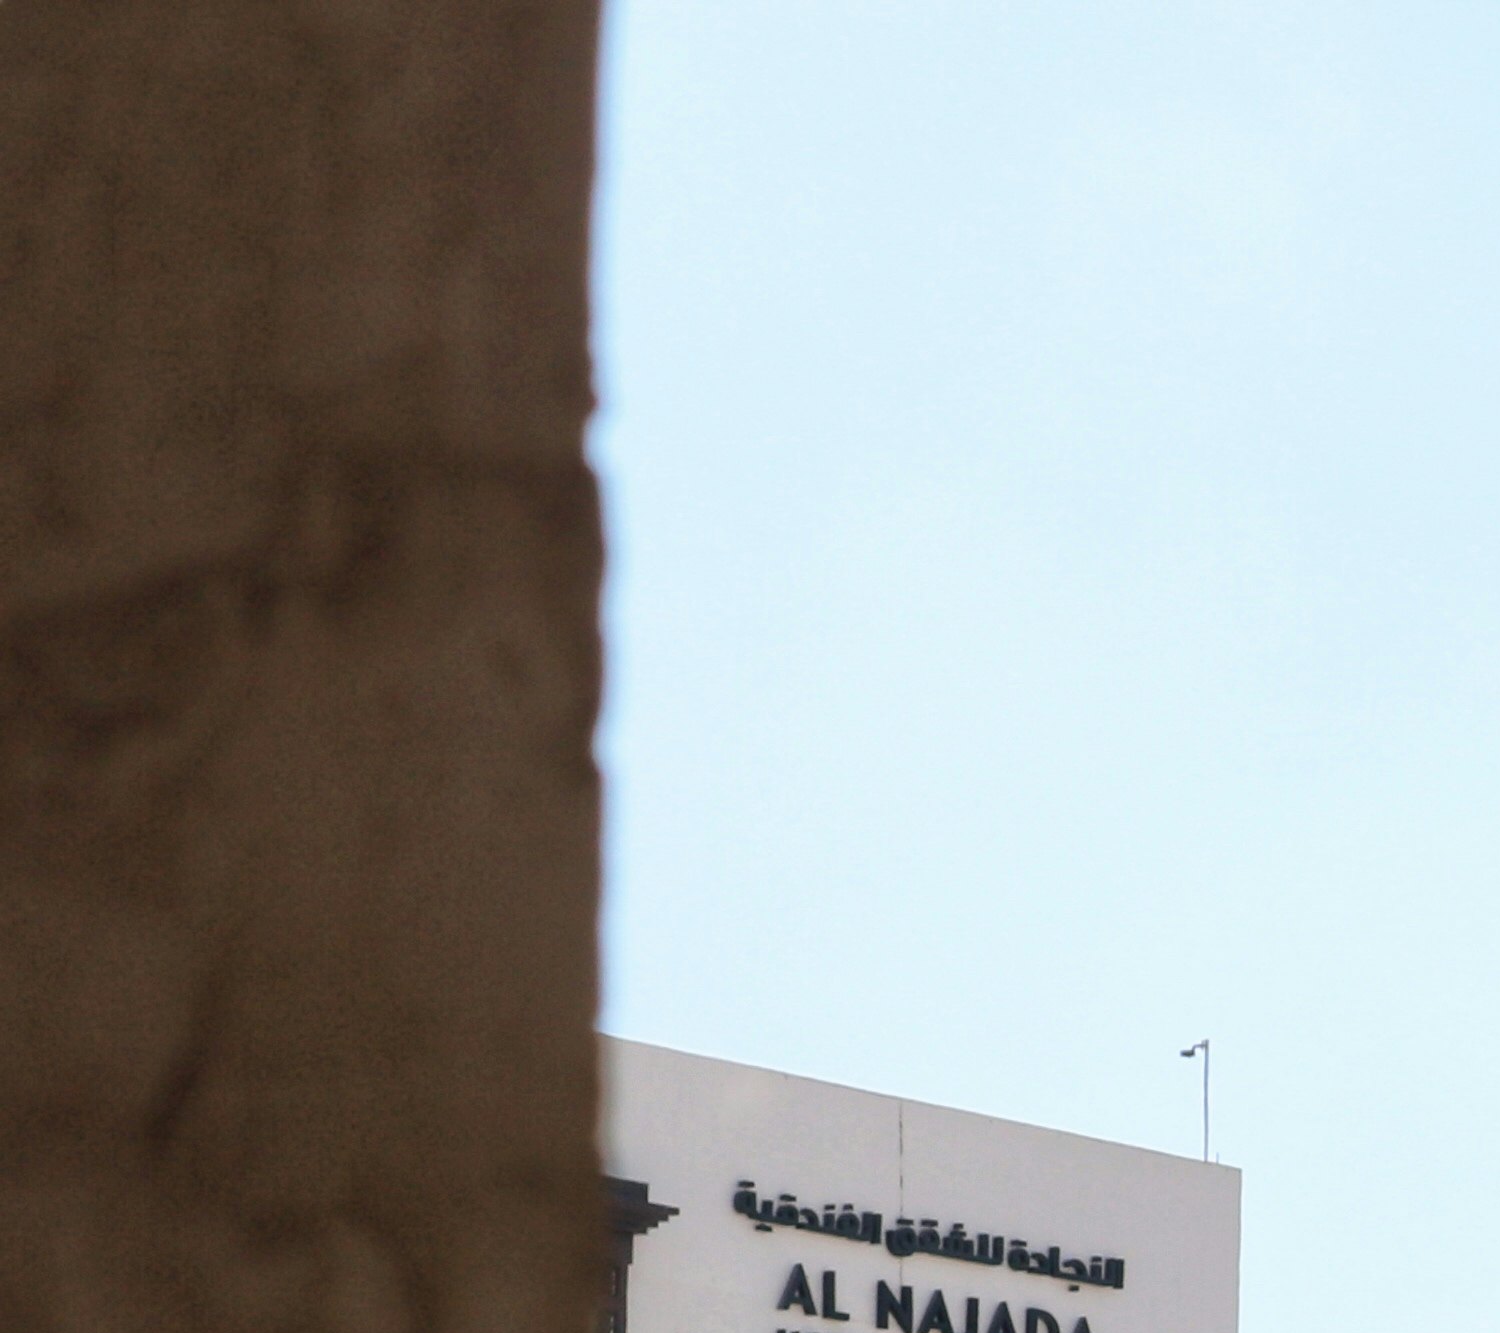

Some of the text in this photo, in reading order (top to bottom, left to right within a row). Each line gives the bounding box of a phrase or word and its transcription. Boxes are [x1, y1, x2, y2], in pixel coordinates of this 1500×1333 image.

[732, 1180, 1125, 1292] النجادة للشقق الفندقية
[776, 1263, 850, 1322] AL
